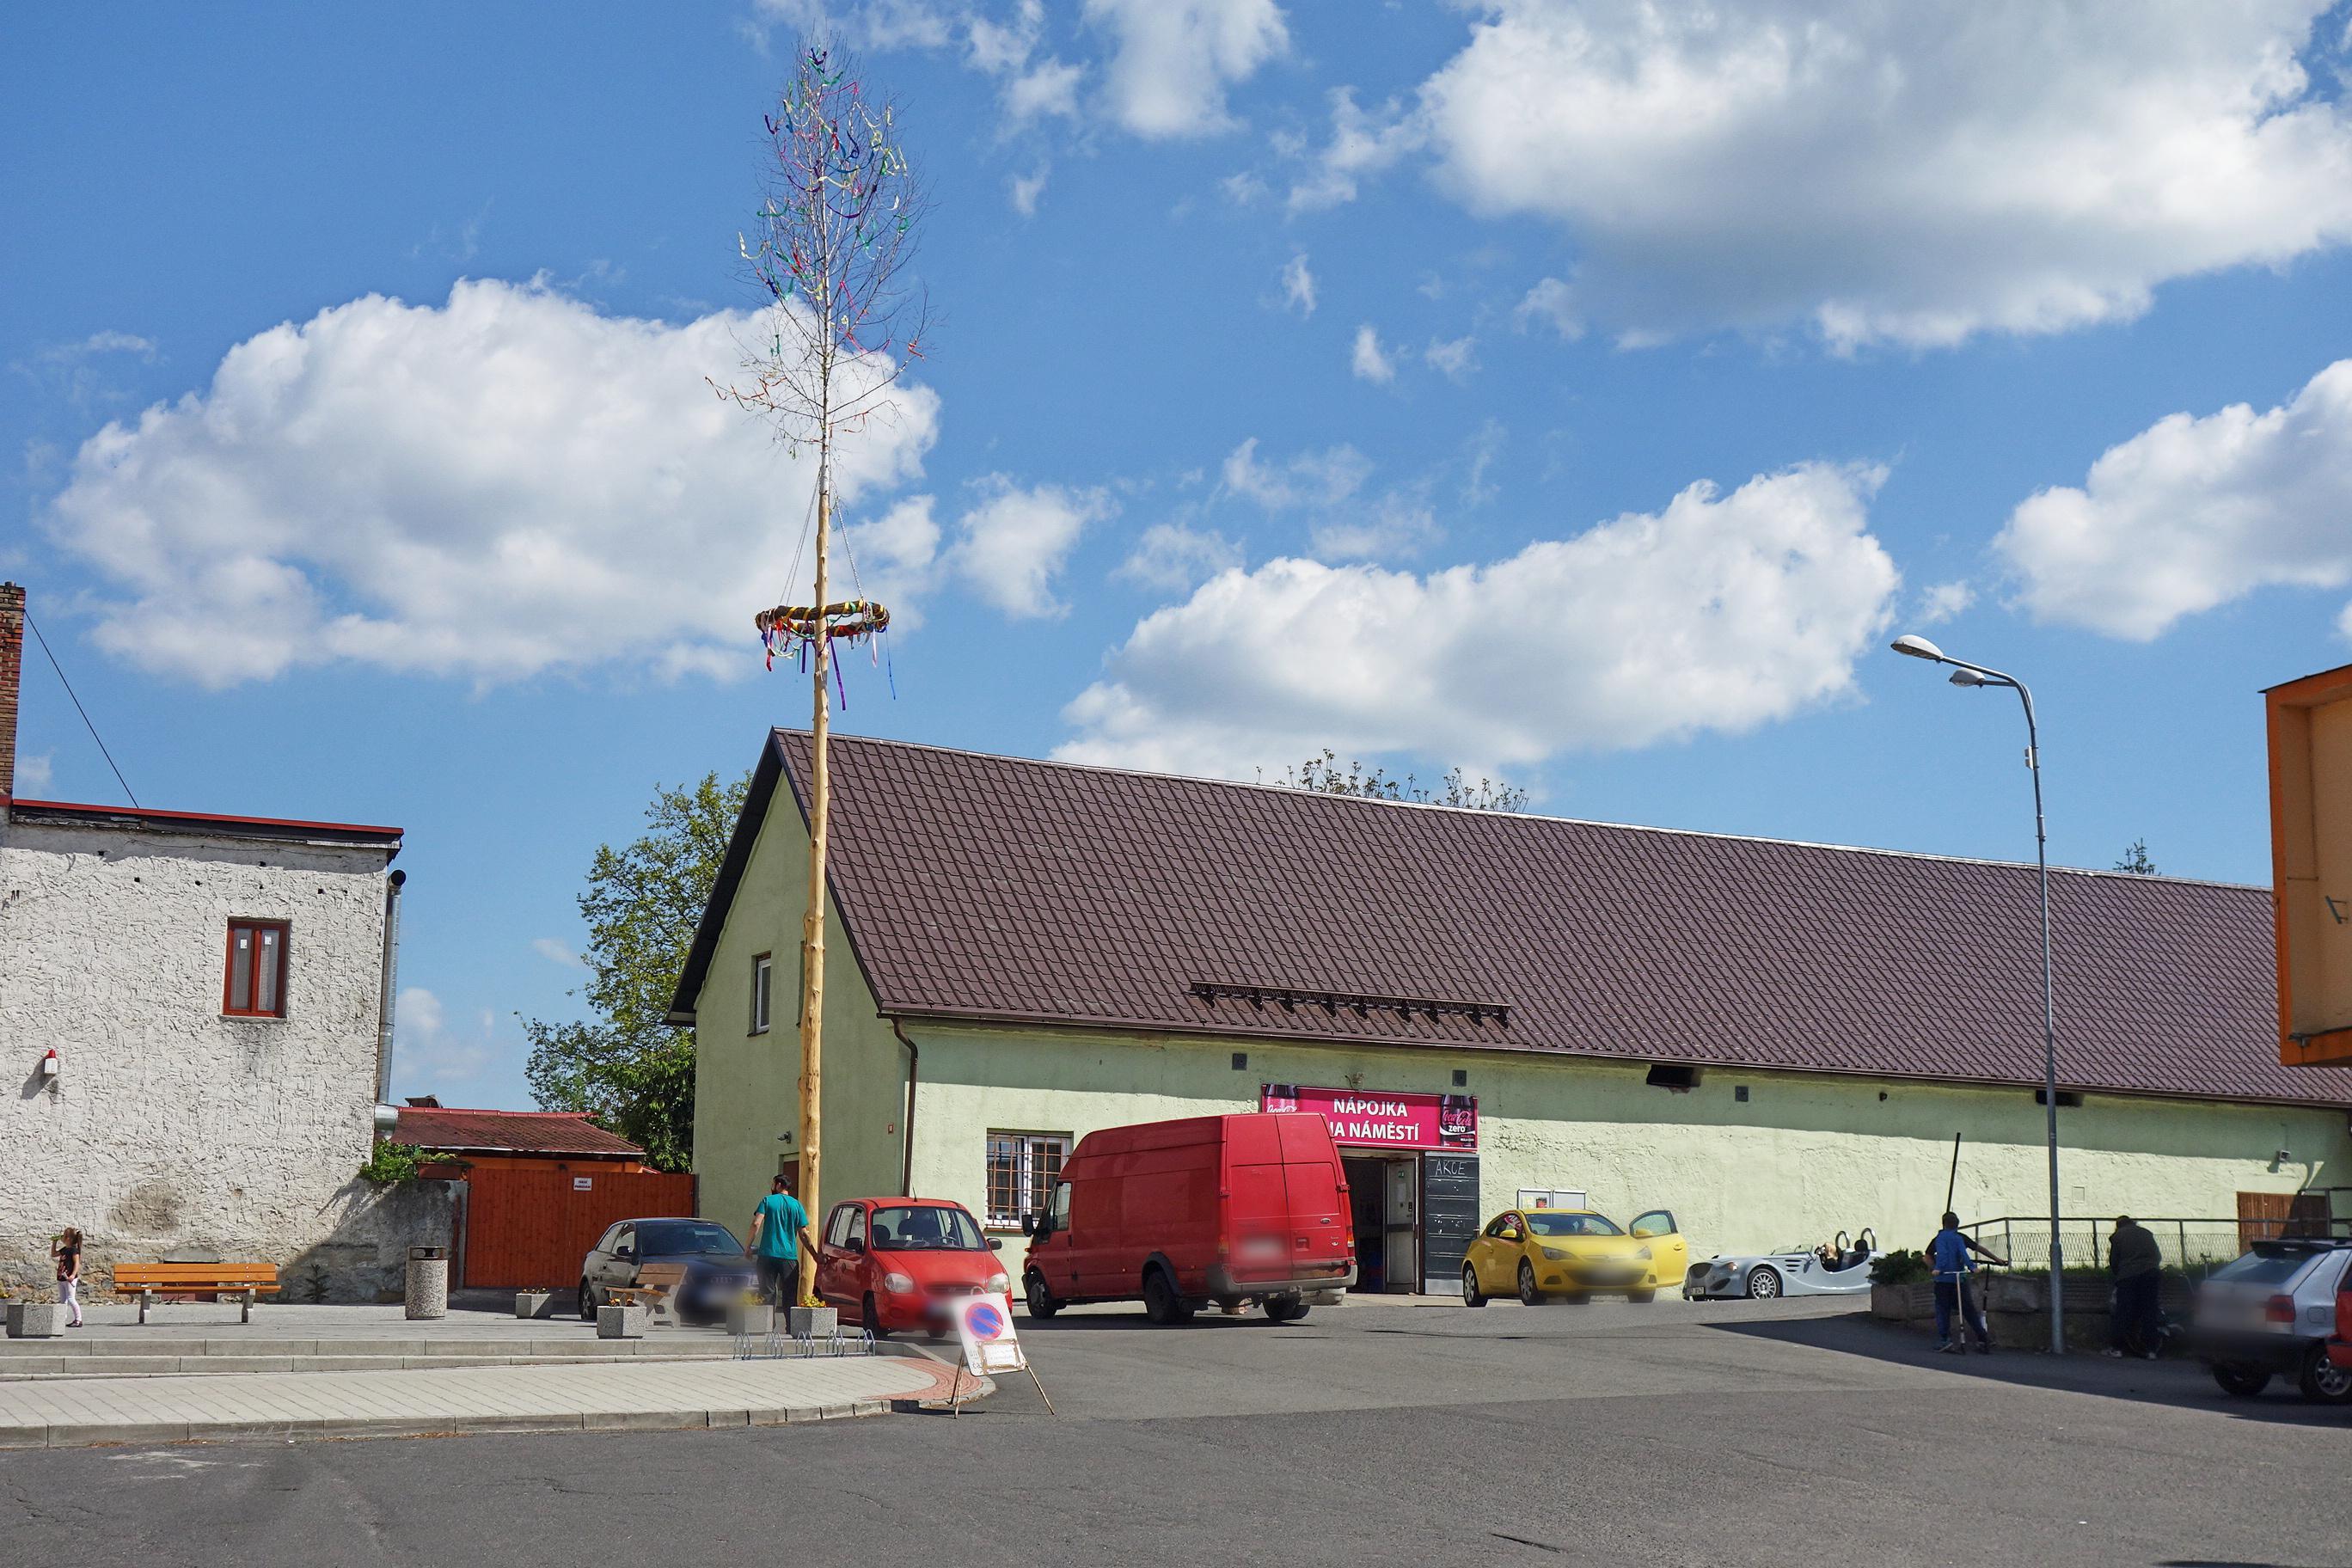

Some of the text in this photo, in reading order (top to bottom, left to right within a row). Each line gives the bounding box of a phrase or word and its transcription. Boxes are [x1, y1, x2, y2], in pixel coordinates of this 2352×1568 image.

[1333, 1096, 1408, 1118] NÁPOJKA
[1349, 1120, 1420, 1141] NÁMĚSTÍ
[1435, 1159, 1467, 1175] AKCE
